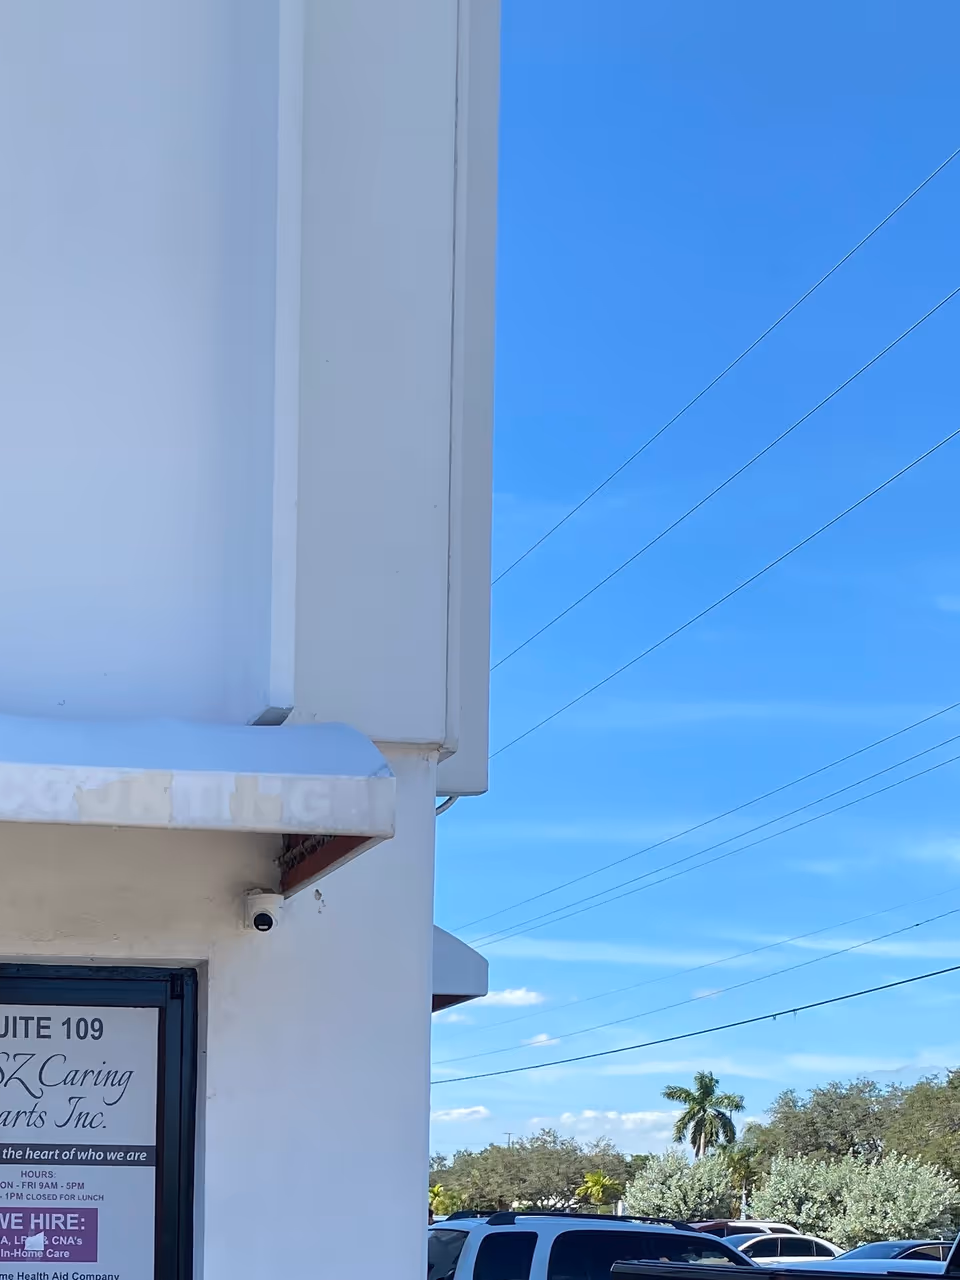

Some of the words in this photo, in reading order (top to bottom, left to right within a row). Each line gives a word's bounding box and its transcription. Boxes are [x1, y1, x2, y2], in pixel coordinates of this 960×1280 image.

[62, 1017, 104, 1040] 109
[38, 1054, 134, 1105] Caring
[55, 1096, 107, 1129] Inc.
[2, 1147, 23, 1160] the
[25, 1148, 59, 1160] heart
[62, 1148, 77, 1160] of
[78, 1149, 104, 1161] who
[106, 1152, 124, 1161] we
[126, 1152, 147, 1161] are
[20, 1170, 56, 1178] HOURS:
[30, 1214, 85, 1230] HIRE:
[52, 1236, 82, 1245] CNA's
[0, 1249, 44, 1258] In-Home
[46, 1249, 70, 1258] Care
[17, 1272, 48, 1280] Health
[52, 1272, 68, 1280] Aid
